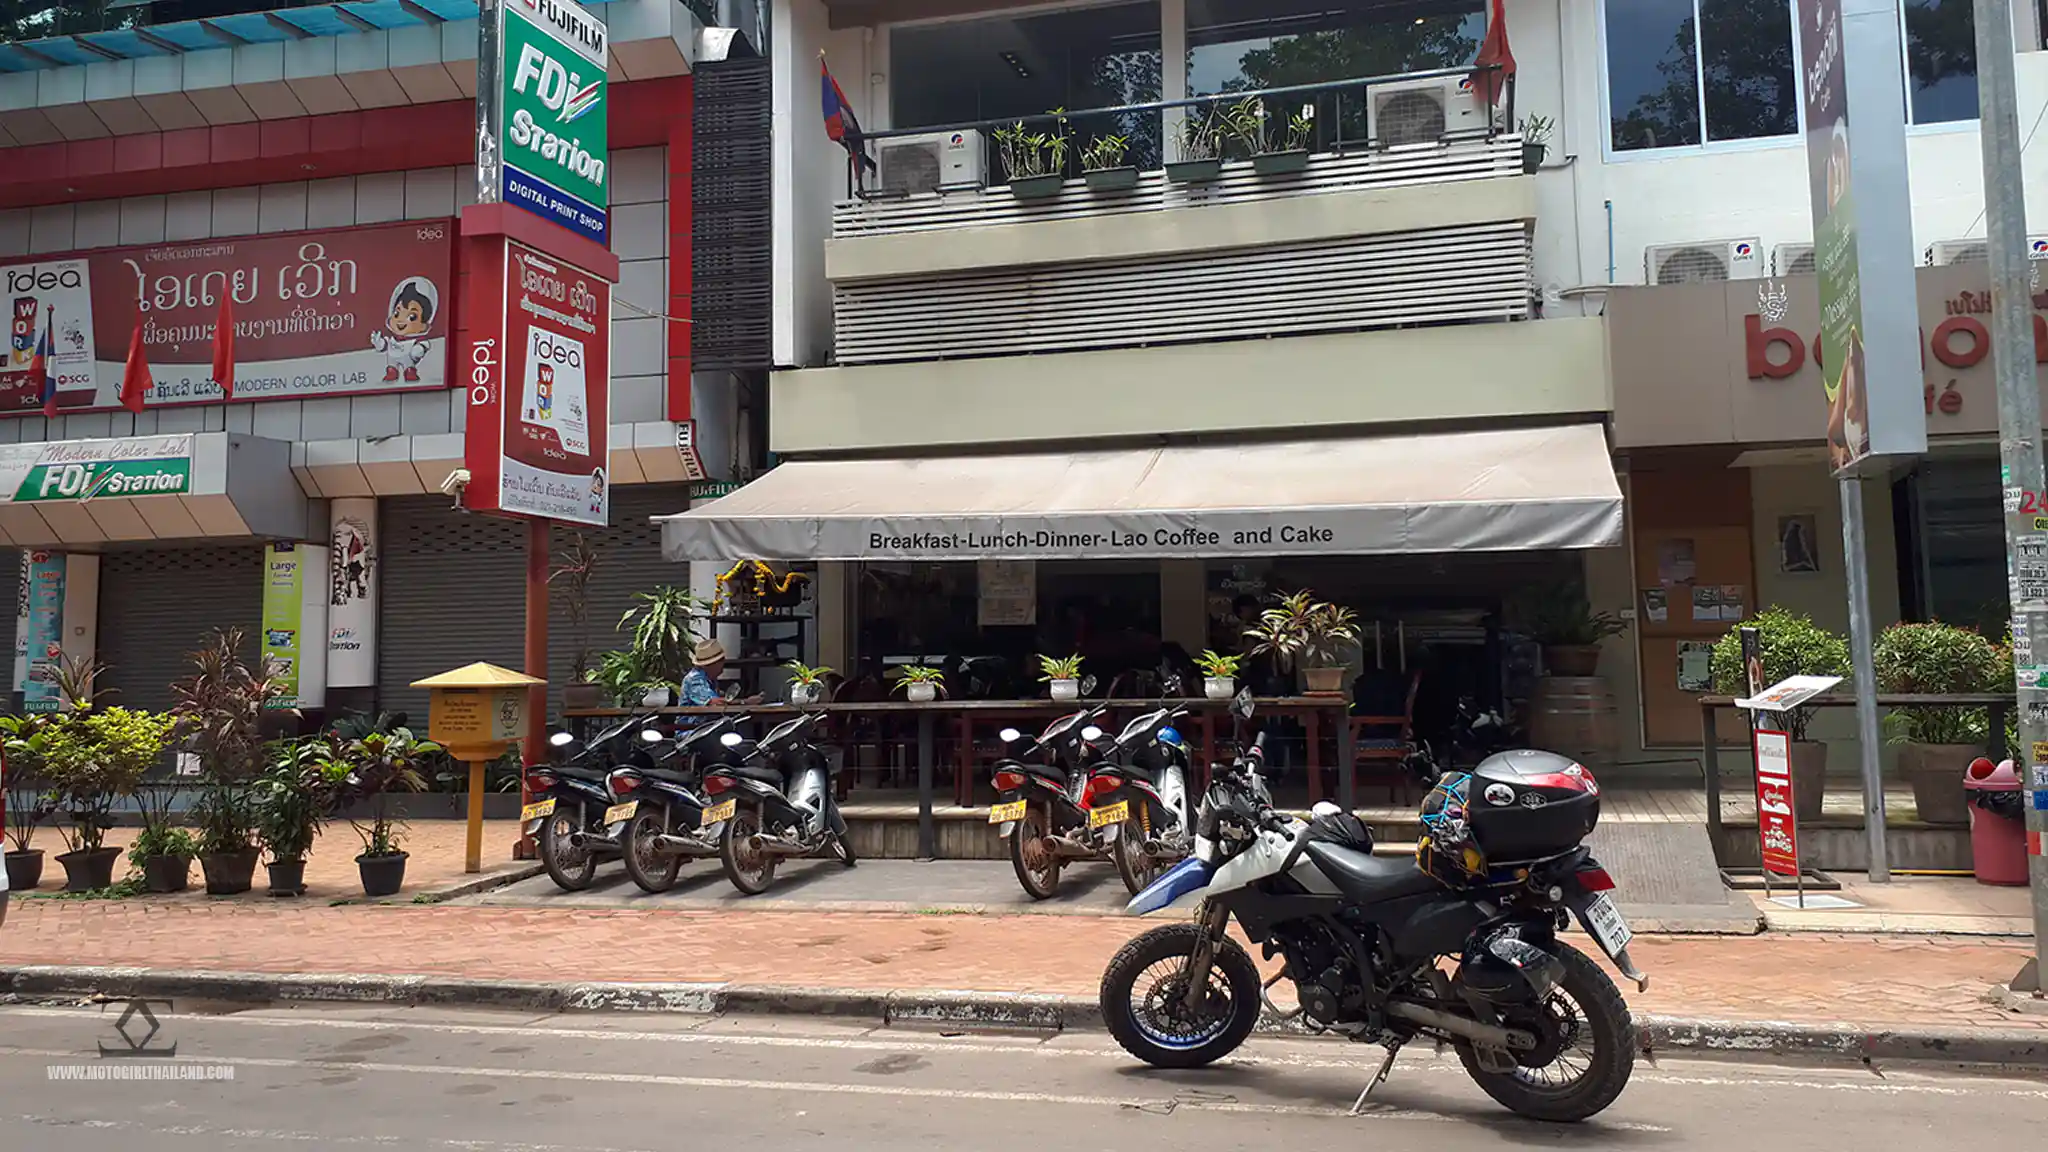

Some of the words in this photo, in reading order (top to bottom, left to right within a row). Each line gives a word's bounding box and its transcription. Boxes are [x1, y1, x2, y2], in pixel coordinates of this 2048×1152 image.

[538, 0, 603, 53] FUJIFILM
[513, 42, 581, 111] FDi
[509, 180, 548, 207] DIGITAL
[551, 197, 579, 221] PRINT
[580, 212, 604, 232] SHOP
[7, 266, 82, 293] idea
[14, 302, 36, 361] WORK
[533, 332, 581, 369] idea
[69, 374, 90, 383] SCG
[235, 377, 287, 392] MODERN
[293, 373, 336, 388] COLOR
[342, 371, 366, 385] LAB
[472, 338, 497, 406] idea
[47, 443, 103, 461] Modern
[108, 443, 148, 460] Color
[154, 438, 187, 456] Lab
[678, 423, 700, 477] FUJIFILM
[40, 463, 95, 498] FDi
[108, 470, 184, 493] Station
[1154, 528, 1220, 546] Coffee
[1233, 527, 1272, 544] and
[1280, 526, 1334, 543] Cake
[270, 561, 296, 572] Large
[1610, 926, 1627, 949] 707
